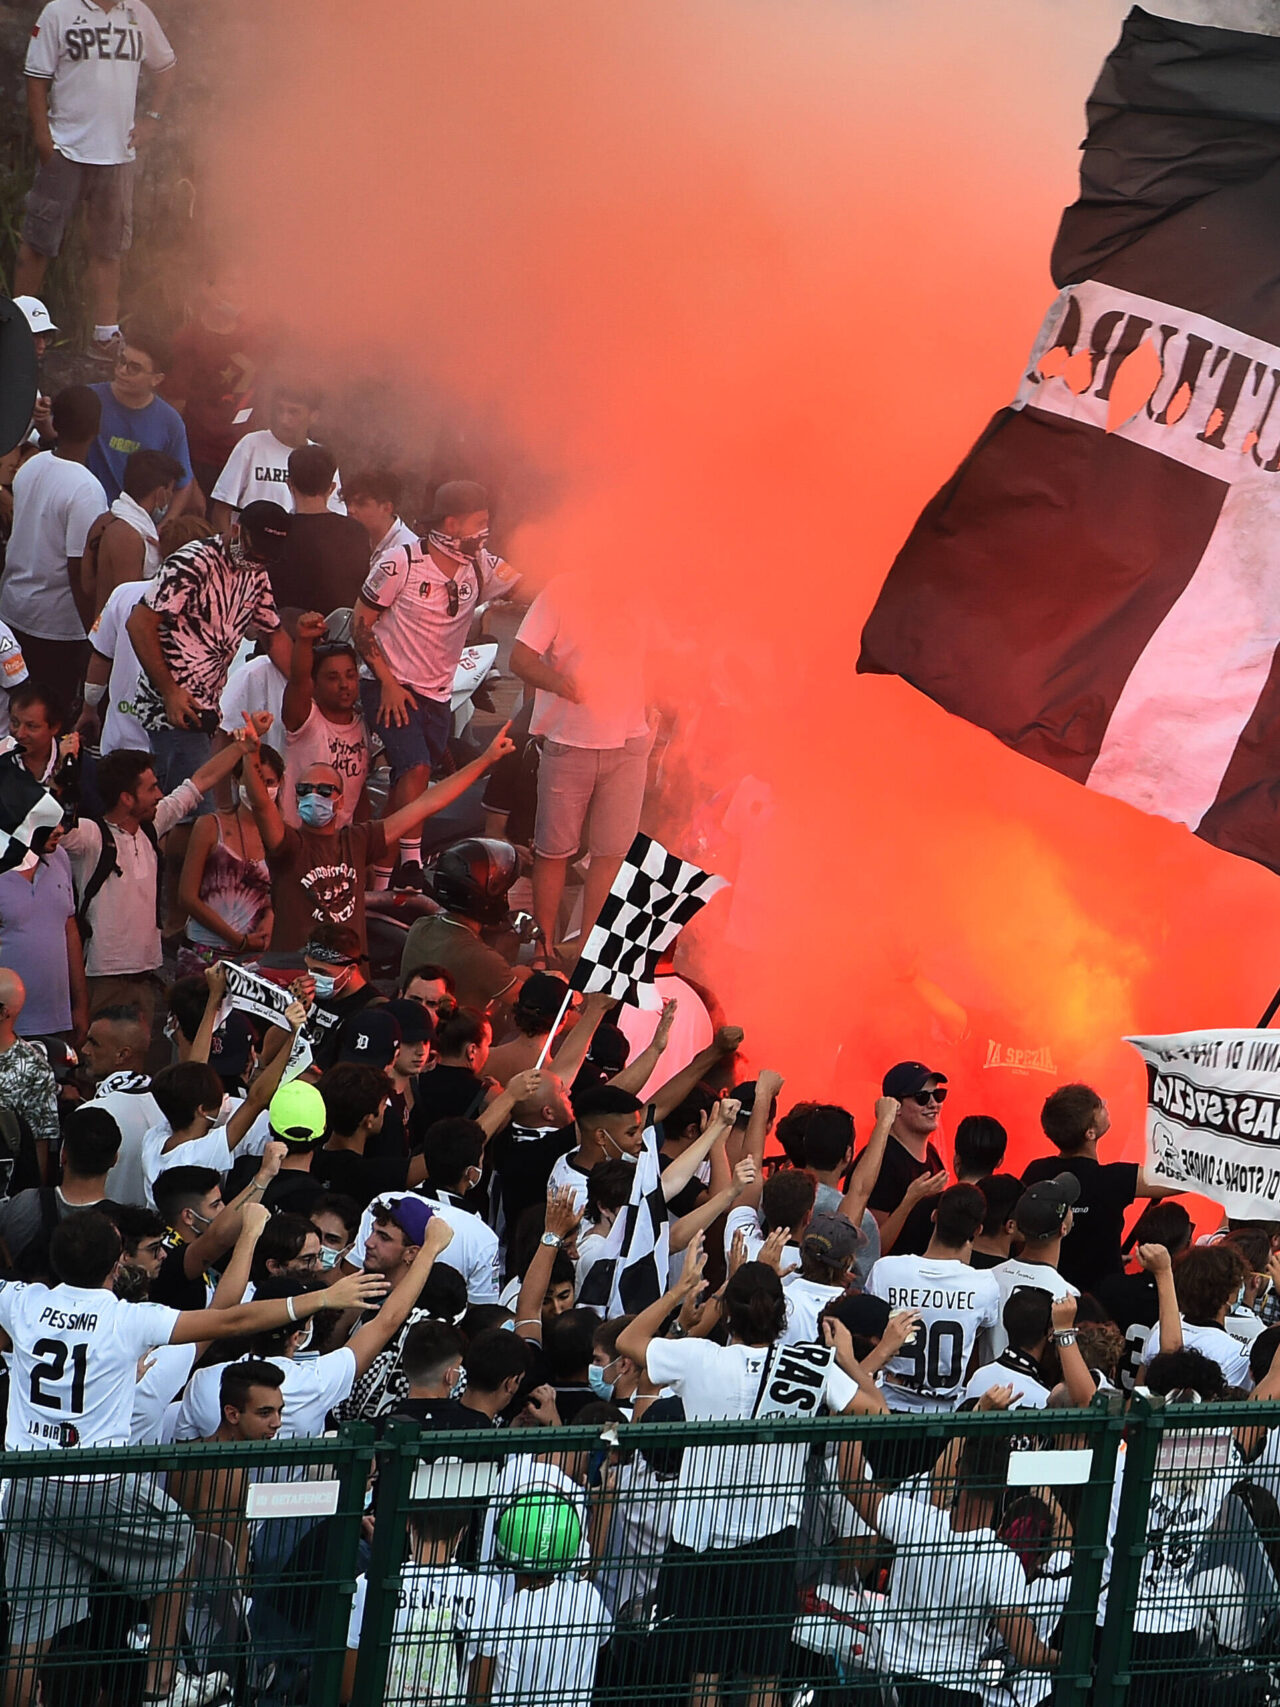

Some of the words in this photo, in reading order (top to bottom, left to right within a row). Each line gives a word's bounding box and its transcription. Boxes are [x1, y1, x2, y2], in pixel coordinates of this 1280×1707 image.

[1005, 1046, 1054, 1069] SPEZIA
[888, 1287, 976, 1310] BREZOVEC
[39, 1306, 99, 1333] PESSINA
[890, 1318, 964, 1389] 30
[29, 1338, 89, 1414] 21
[28, 1420, 40, 1435] LA
